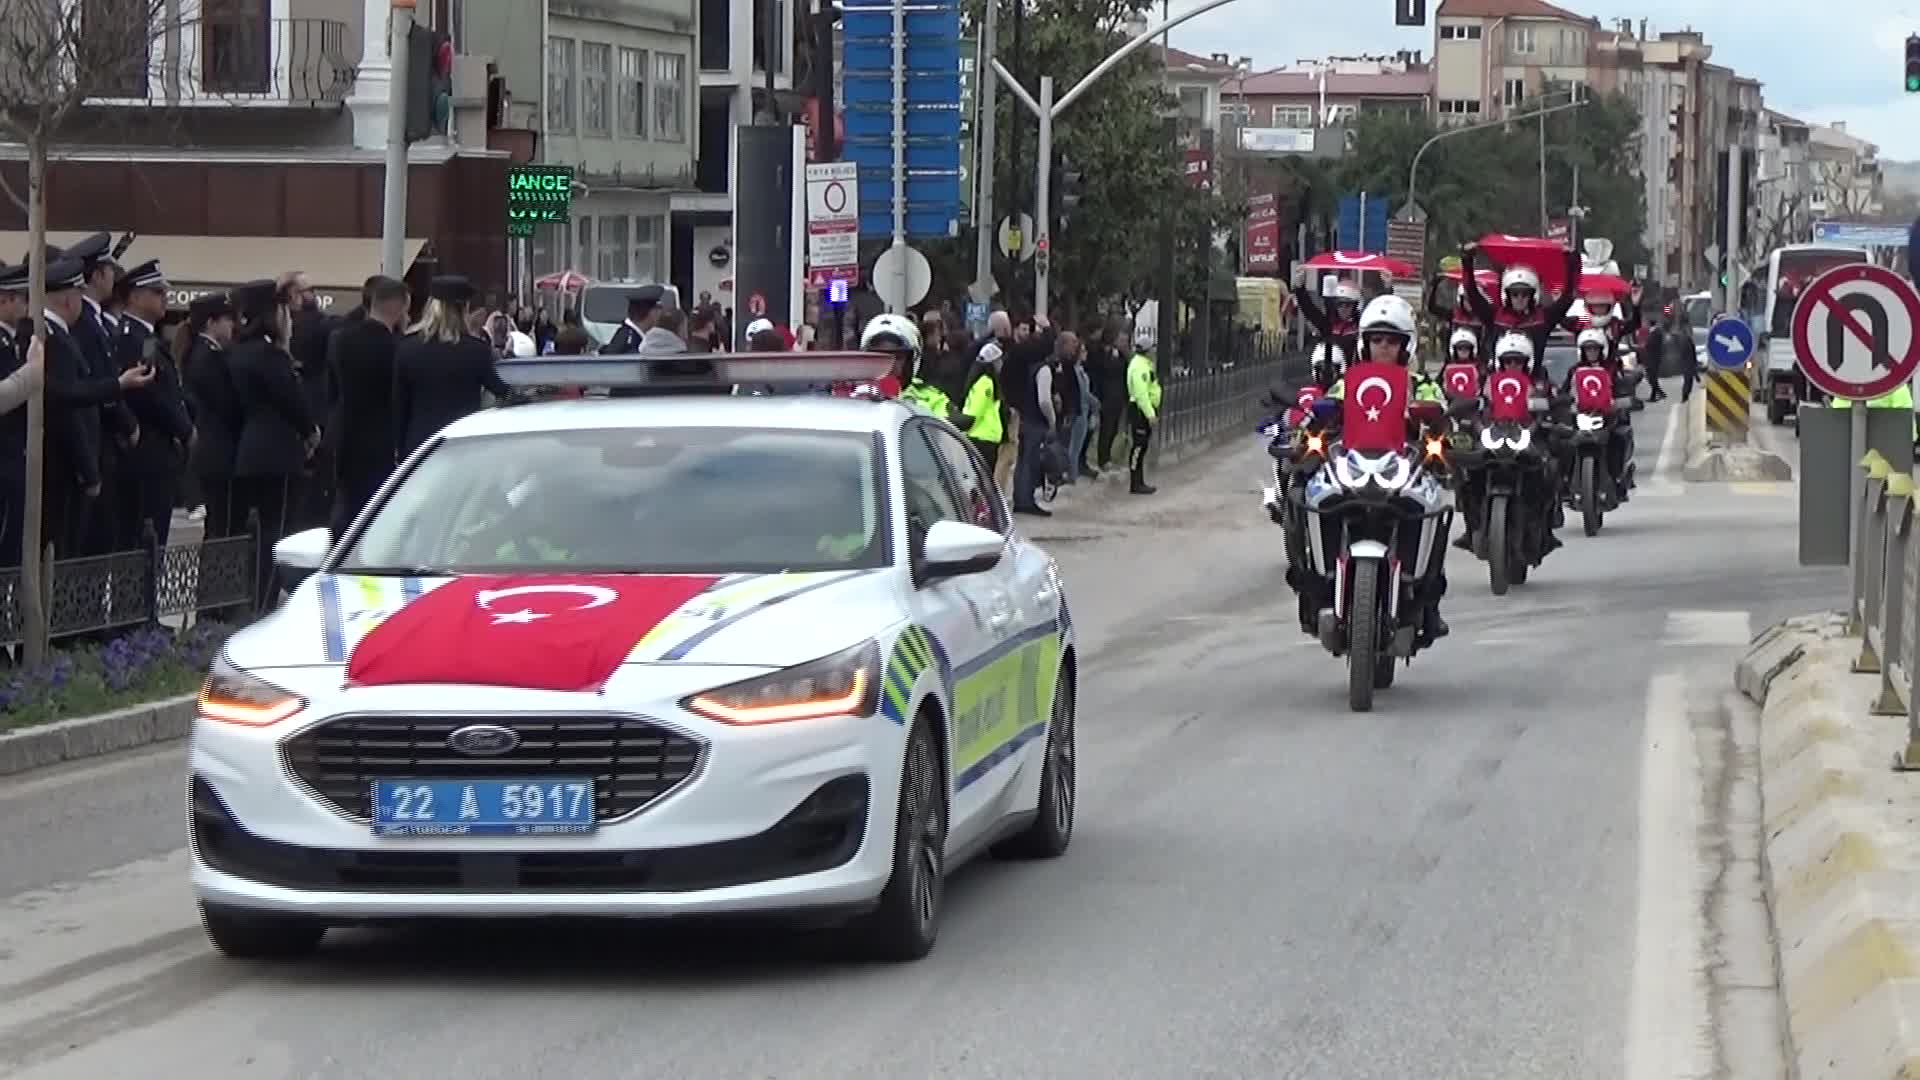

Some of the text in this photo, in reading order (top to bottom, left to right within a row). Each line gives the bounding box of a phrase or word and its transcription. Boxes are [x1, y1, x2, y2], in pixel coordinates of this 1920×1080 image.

[391, 785, 435, 820] 22
[458, 785, 480, 819] A
[501, 783, 588, 819] 5917
